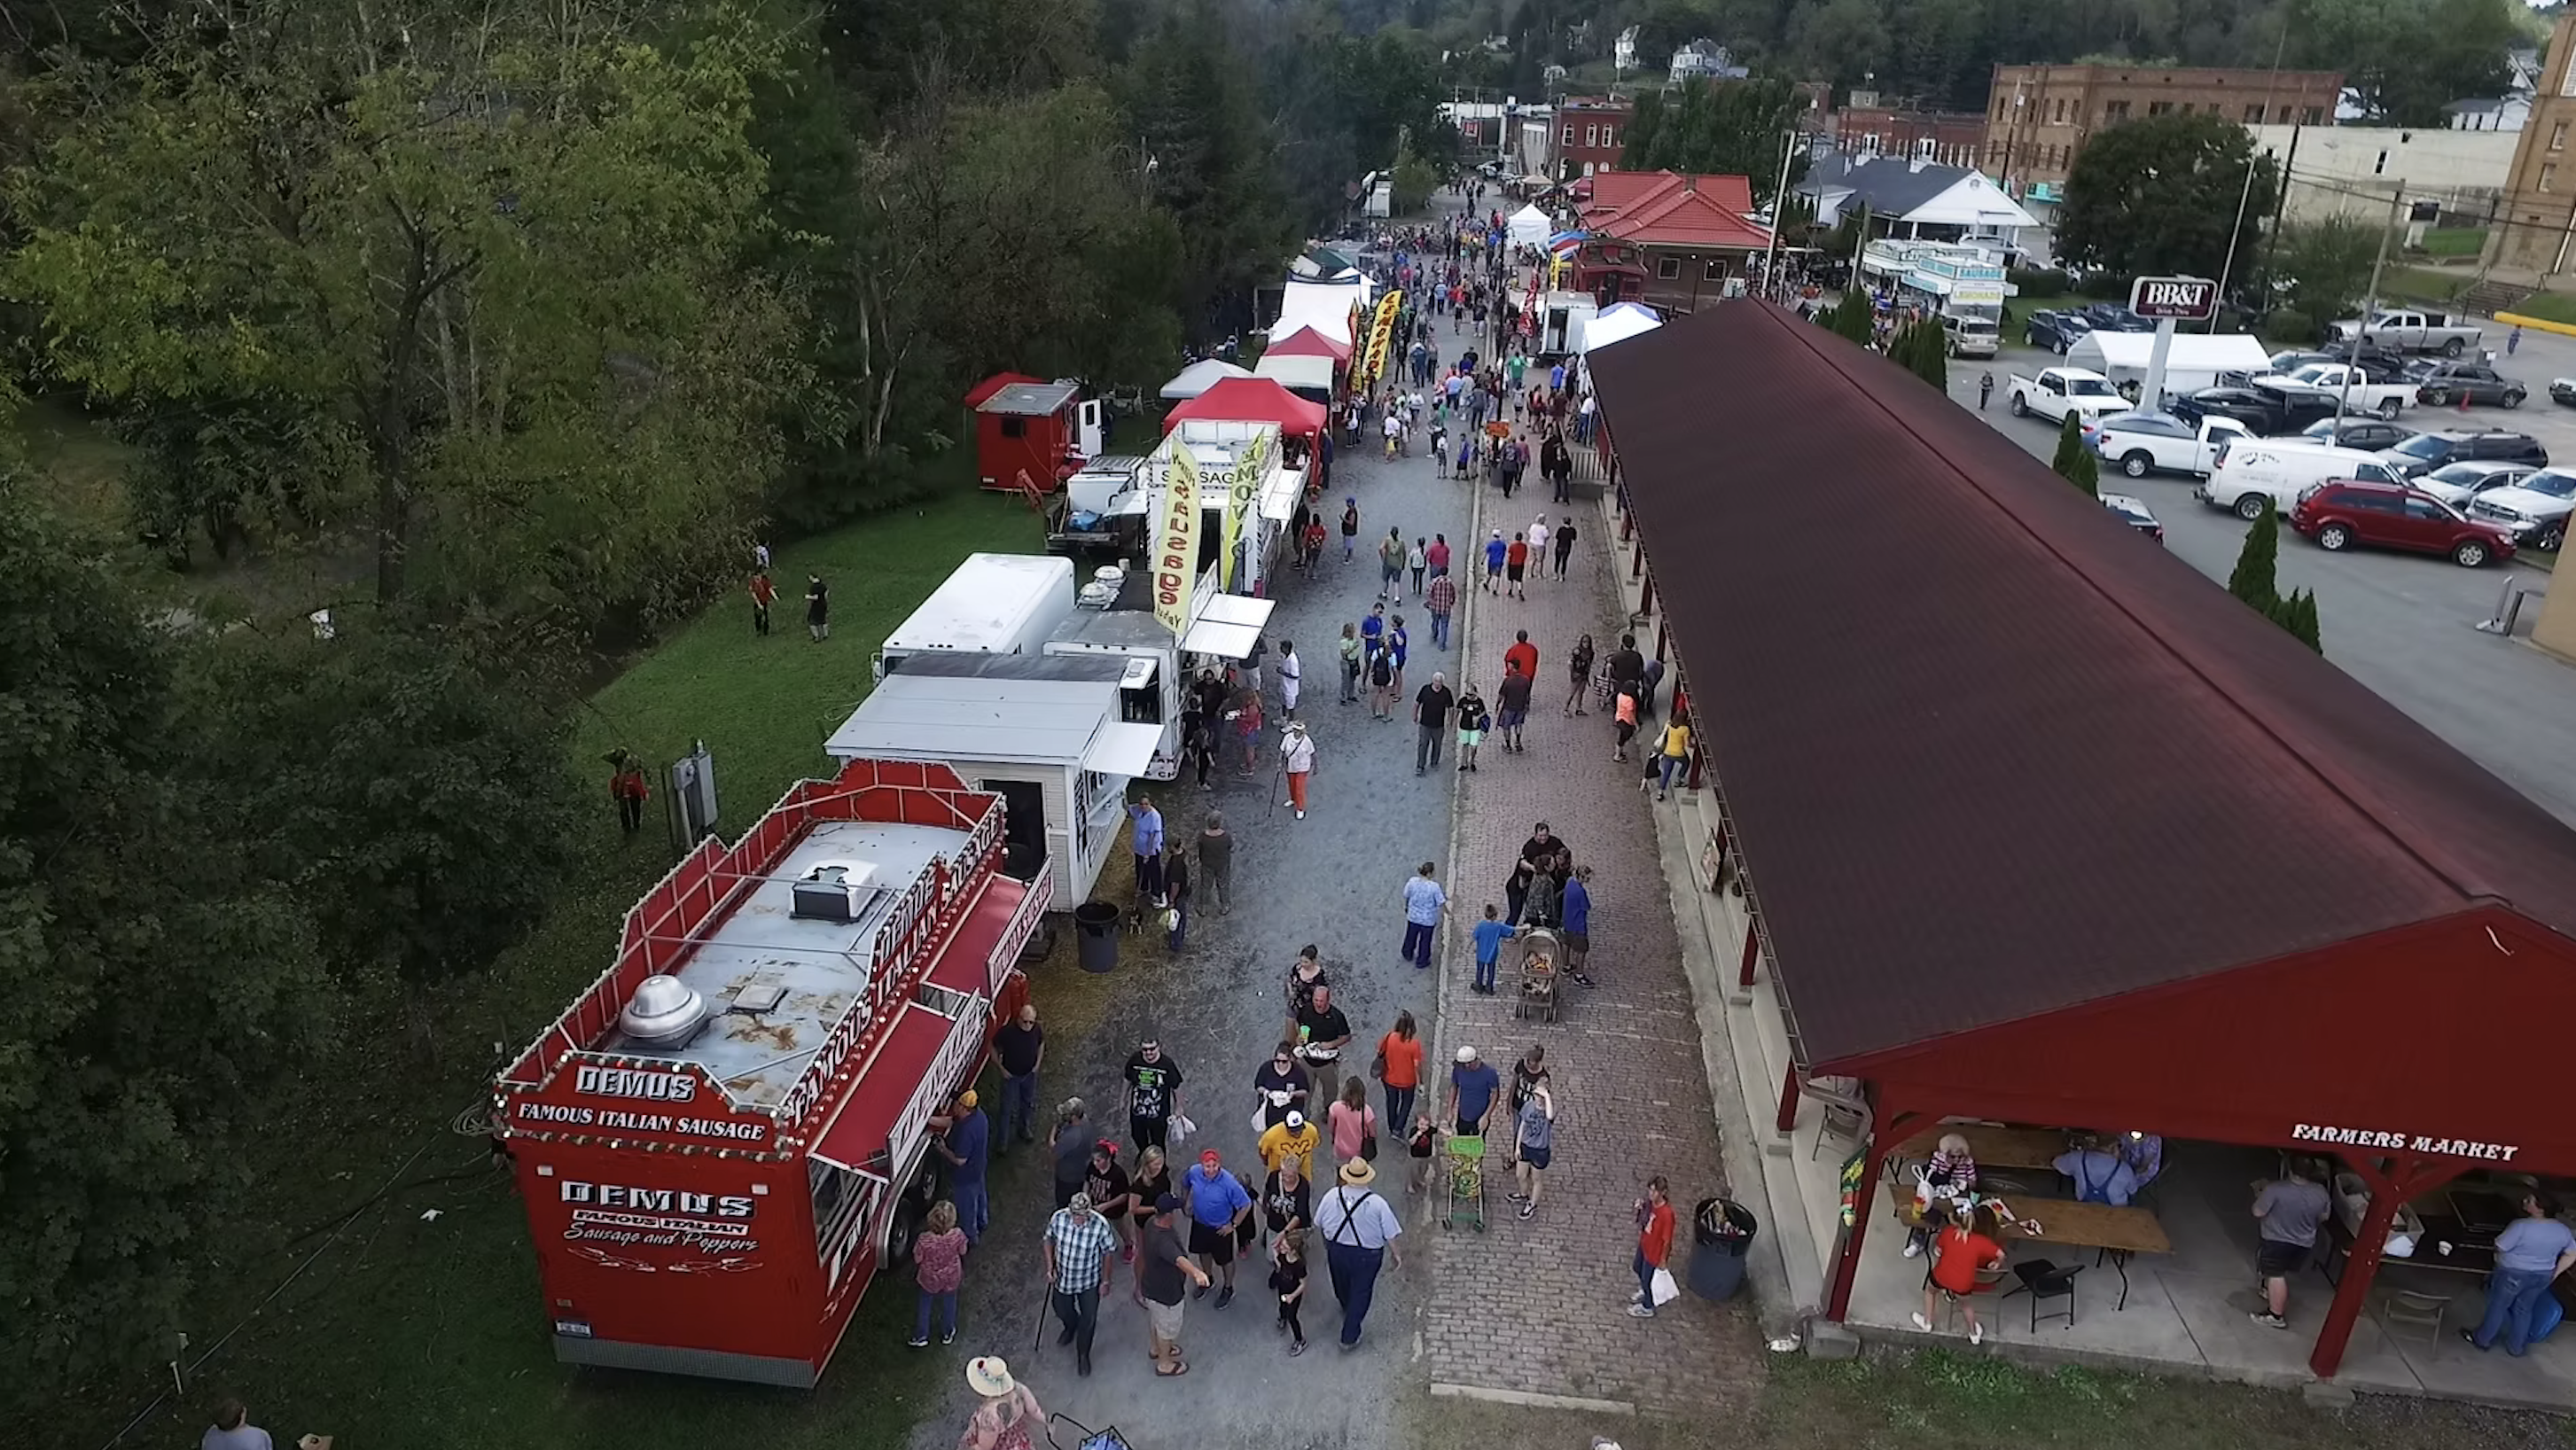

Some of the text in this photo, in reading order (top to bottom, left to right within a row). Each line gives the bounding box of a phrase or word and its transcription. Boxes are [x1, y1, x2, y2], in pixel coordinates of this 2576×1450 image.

[2146, 282, 2208, 306] BB&T
[794, 995, 872, 1129] FAMOUS
[877, 900, 939, 1008] ITALIAN
[940, 815, 998, 914] SAUSAGE
[576, 1065, 697, 1102] DEMUS
[518, 1103, 766, 1141] FAMOUS ITALIAN SAUSAGE
[2292, 1123, 2518, 1162] FARMERS MARKET
[561, 1181, 755, 1218] DEMUS
[564, 1222, 760, 1254] Sausage and Peppers
[575, 1211, 745, 1234] FAMOUS ITALIAN
